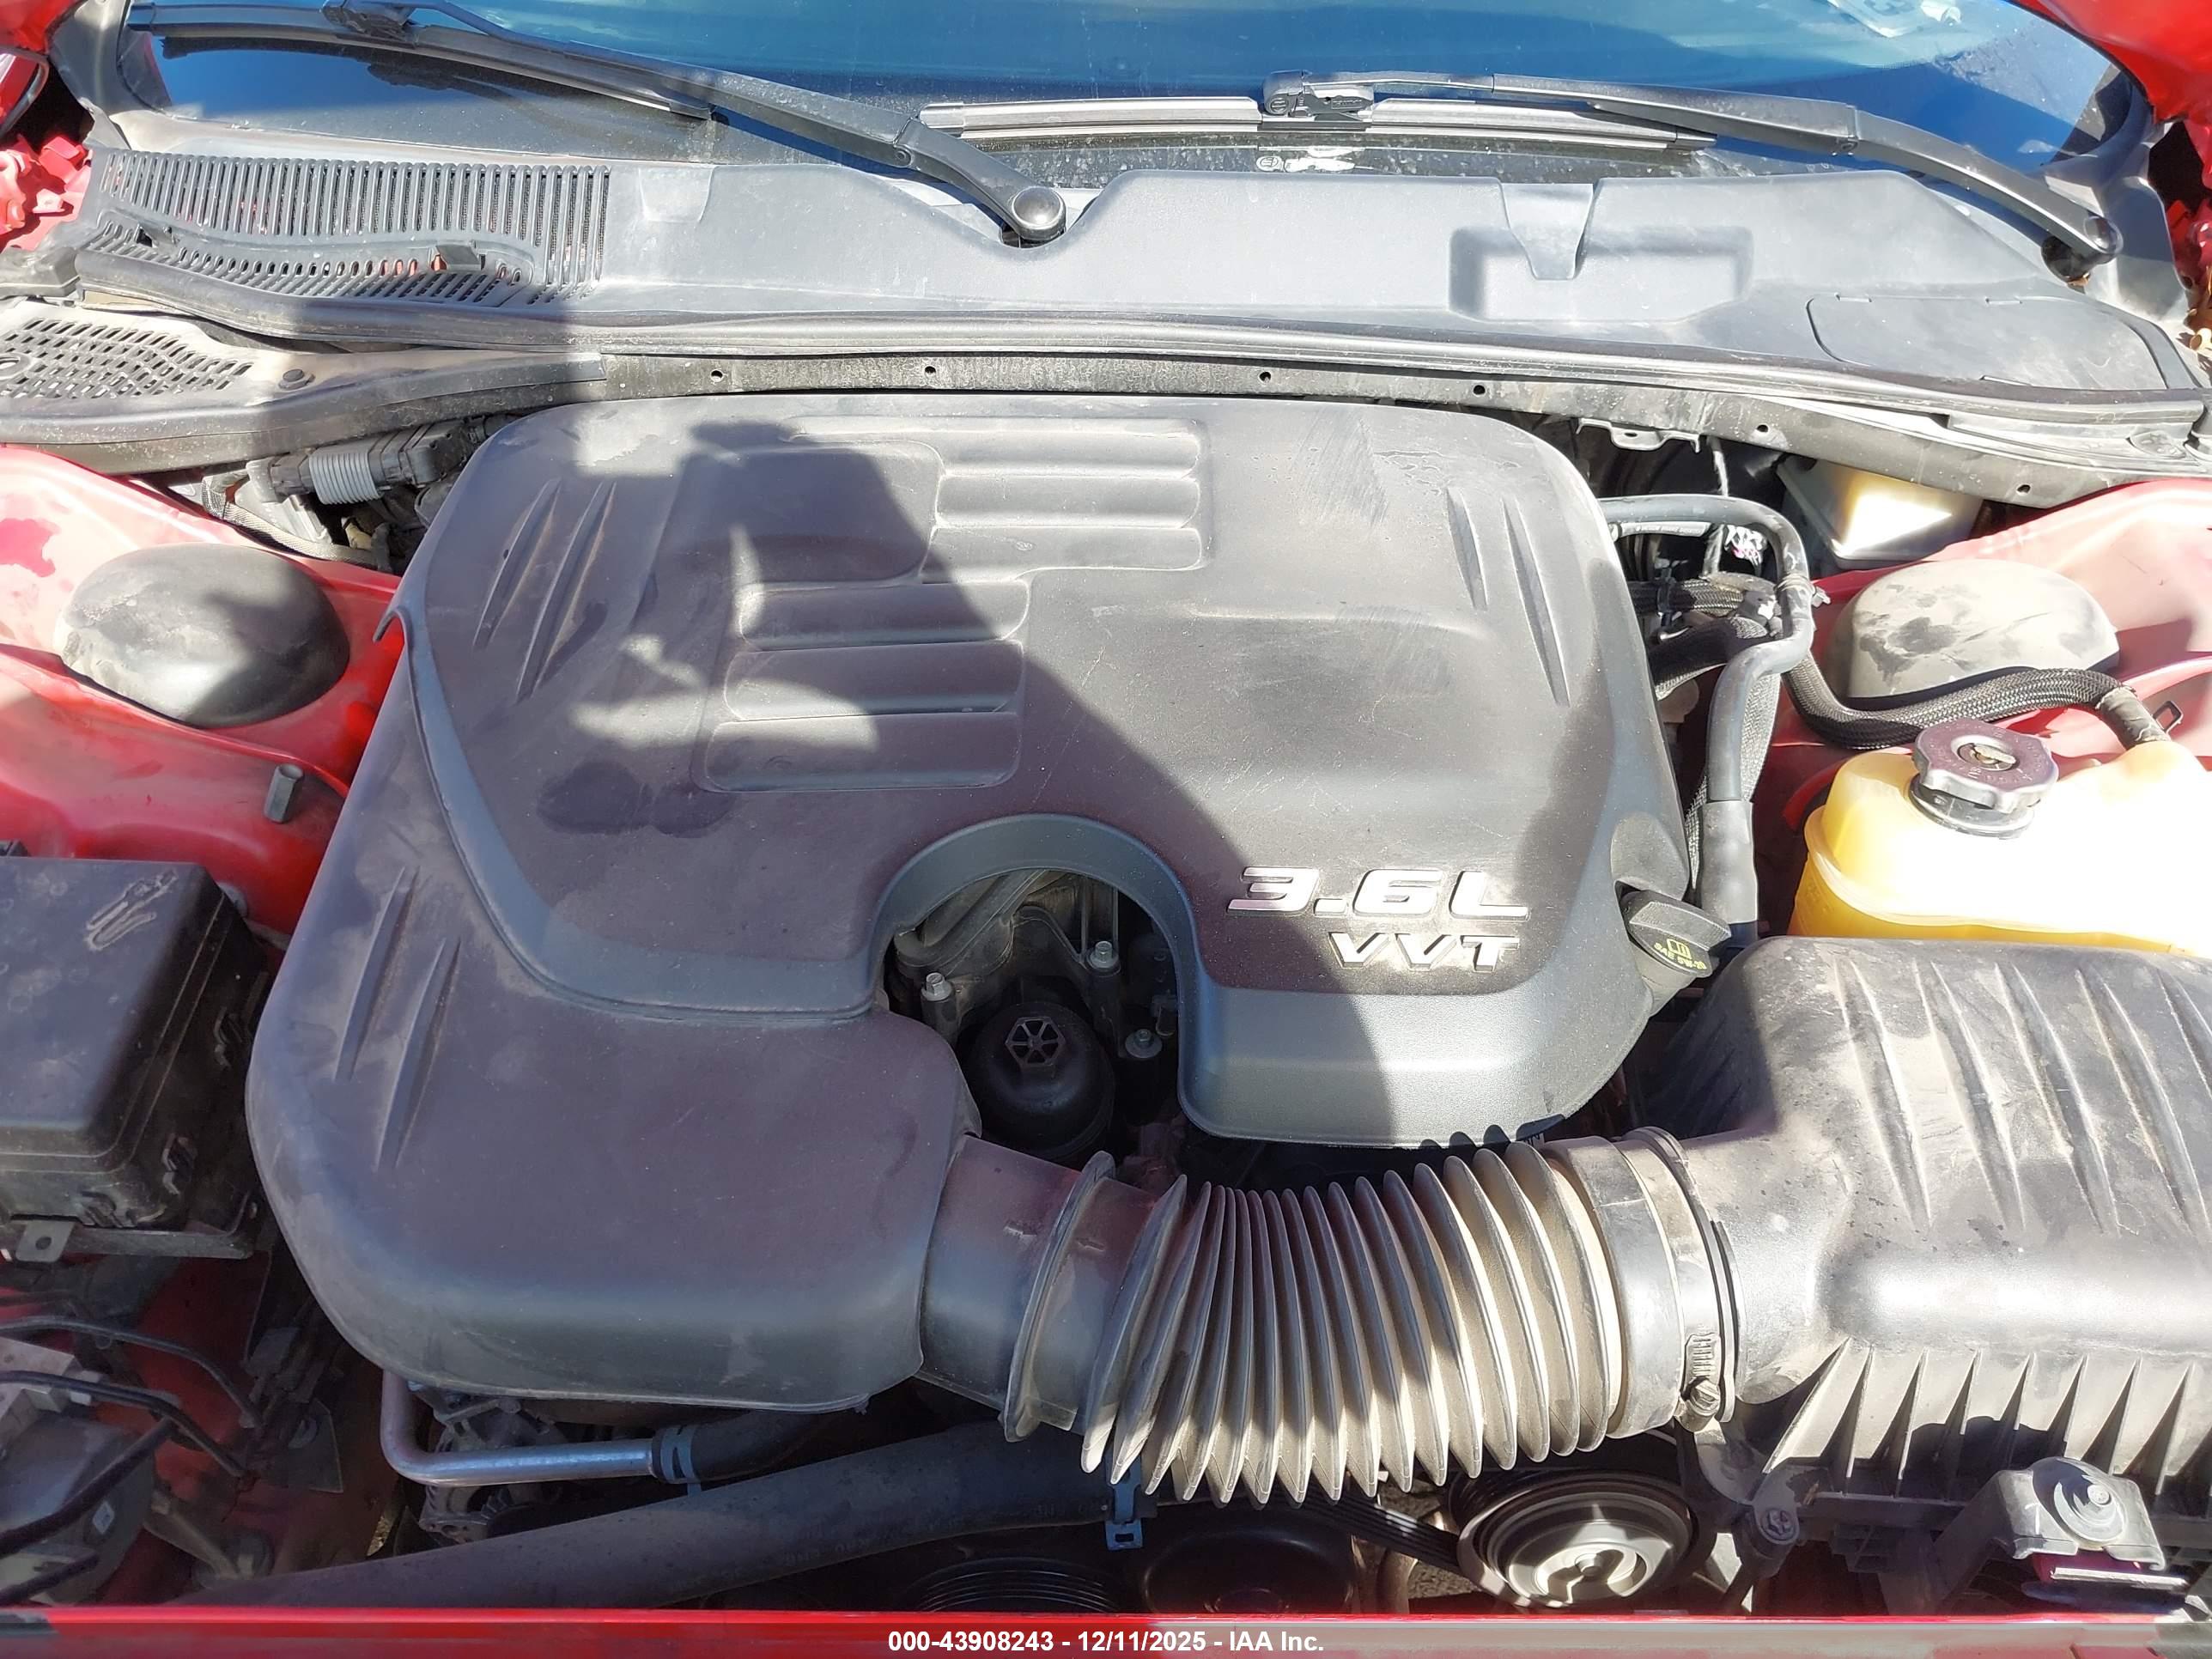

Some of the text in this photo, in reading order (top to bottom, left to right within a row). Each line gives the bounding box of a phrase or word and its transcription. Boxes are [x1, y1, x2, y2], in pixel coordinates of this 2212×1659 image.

[1226, 866, 1531, 921] 3.6L
[1328, 932, 1521, 973] VVT
[1654, 942, 1675, 960] SAE
